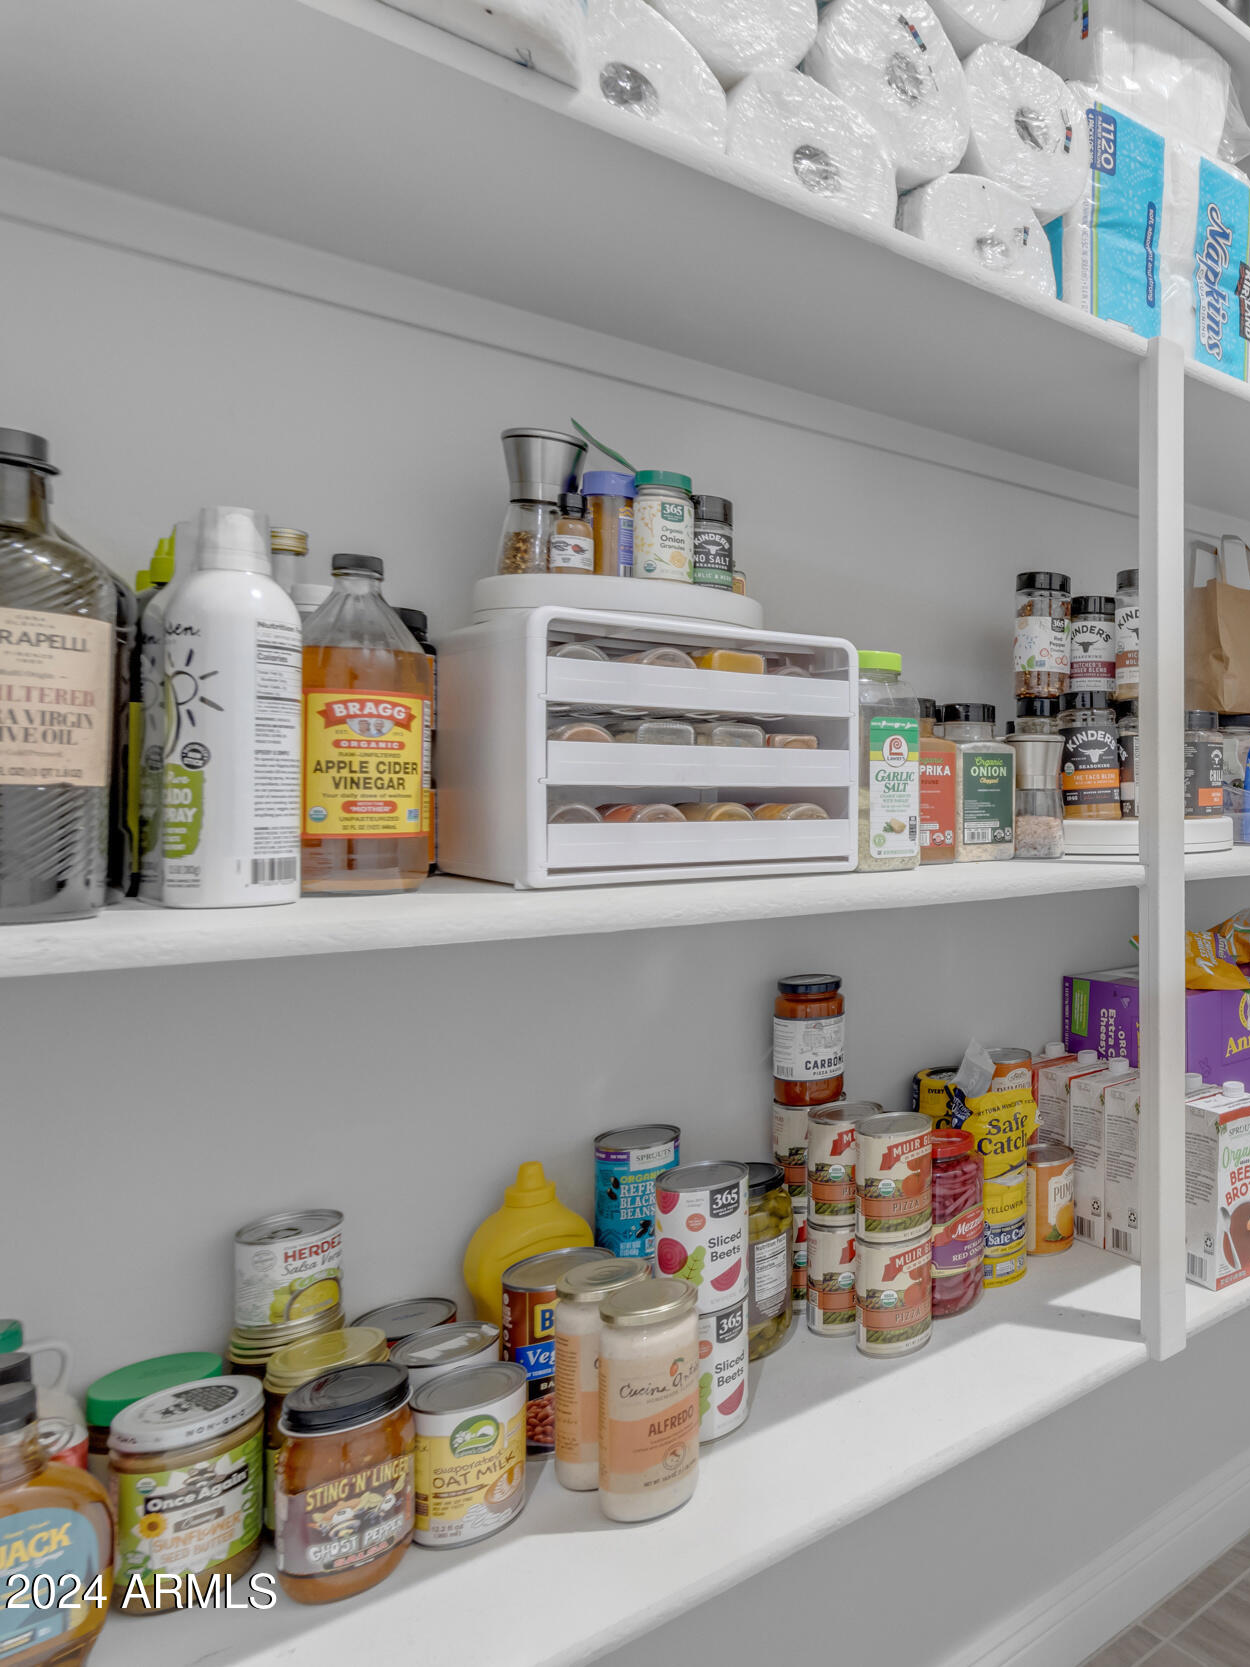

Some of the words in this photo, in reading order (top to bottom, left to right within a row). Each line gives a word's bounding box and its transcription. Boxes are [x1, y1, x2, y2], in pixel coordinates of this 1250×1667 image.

[1101, 121, 1115, 170] 1120
[1196, 203, 1234, 361] Napkins
[663, 503, 683, 516] 365
[660, 535, 685, 544] Onion
[708, 555, 730, 565] SALT
[0, 629, 88, 652] RAPELLI
[25, 709, 94, 729] VIRGIN
[332, 702, 406, 720] BRAGG
[42, 728, 79, 746] OIL
[340, 740, 400, 749] ORGANIC
[313, 760, 369, 774] APPLE
[376, 761, 418, 775] CIDER
[875, 769, 914, 783] GARLIC
[920, 765, 950, 776] PRIKA
[970, 766, 1007, 776] ONION
[332, 776, 406, 790] VINEGAR
[883, 782, 908, 794] SALT
[1098, 1008, 1108, 1055] Cheesy
[1108, 1008, 1116, 1046] Extra
[985, 1106, 1001, 1115] TUNA
[986, 1112, 1028, 1136] Safe
[893, 1140, 920, 1158] MUIR
[977, 1130, 1028, 1156] Catch
[620, 1194, 656, 1208] BLACK
[712, 1188, 738, 1208] 365
[892, 1200, 920, 1212] PIZZA
[620, 1206, 656, 1220] BEANS
[708, 1228, 742, 1250] Sliced
[988, 1232, 1011, 1246] Safe
[711, 1245, 742, 1263] Beets
[895, 1248, 922, 1268] MUIR
[952, 1252, 969, 1262] RED
[281, 1260, 318, 1276] Salsa
[719, 1310, 742, 1334] 365
[714, 1348, 744, 1375] Sliced
[717, 1366, 744, 1388] Beets
[648, 1404, 694, 1438] ALFREDO
[432, 1471, 472, 1490] OAT
[476, 1451, 516, 1481] MILK
[146, 1489, 194, 1513] Once
[198, 1470, 248, 1499] Again
[306, 1478, 349, 1512] STING
[372, 1456, 410, 1487] LINGER
[310, 1535, 358, 1562] GHOST
